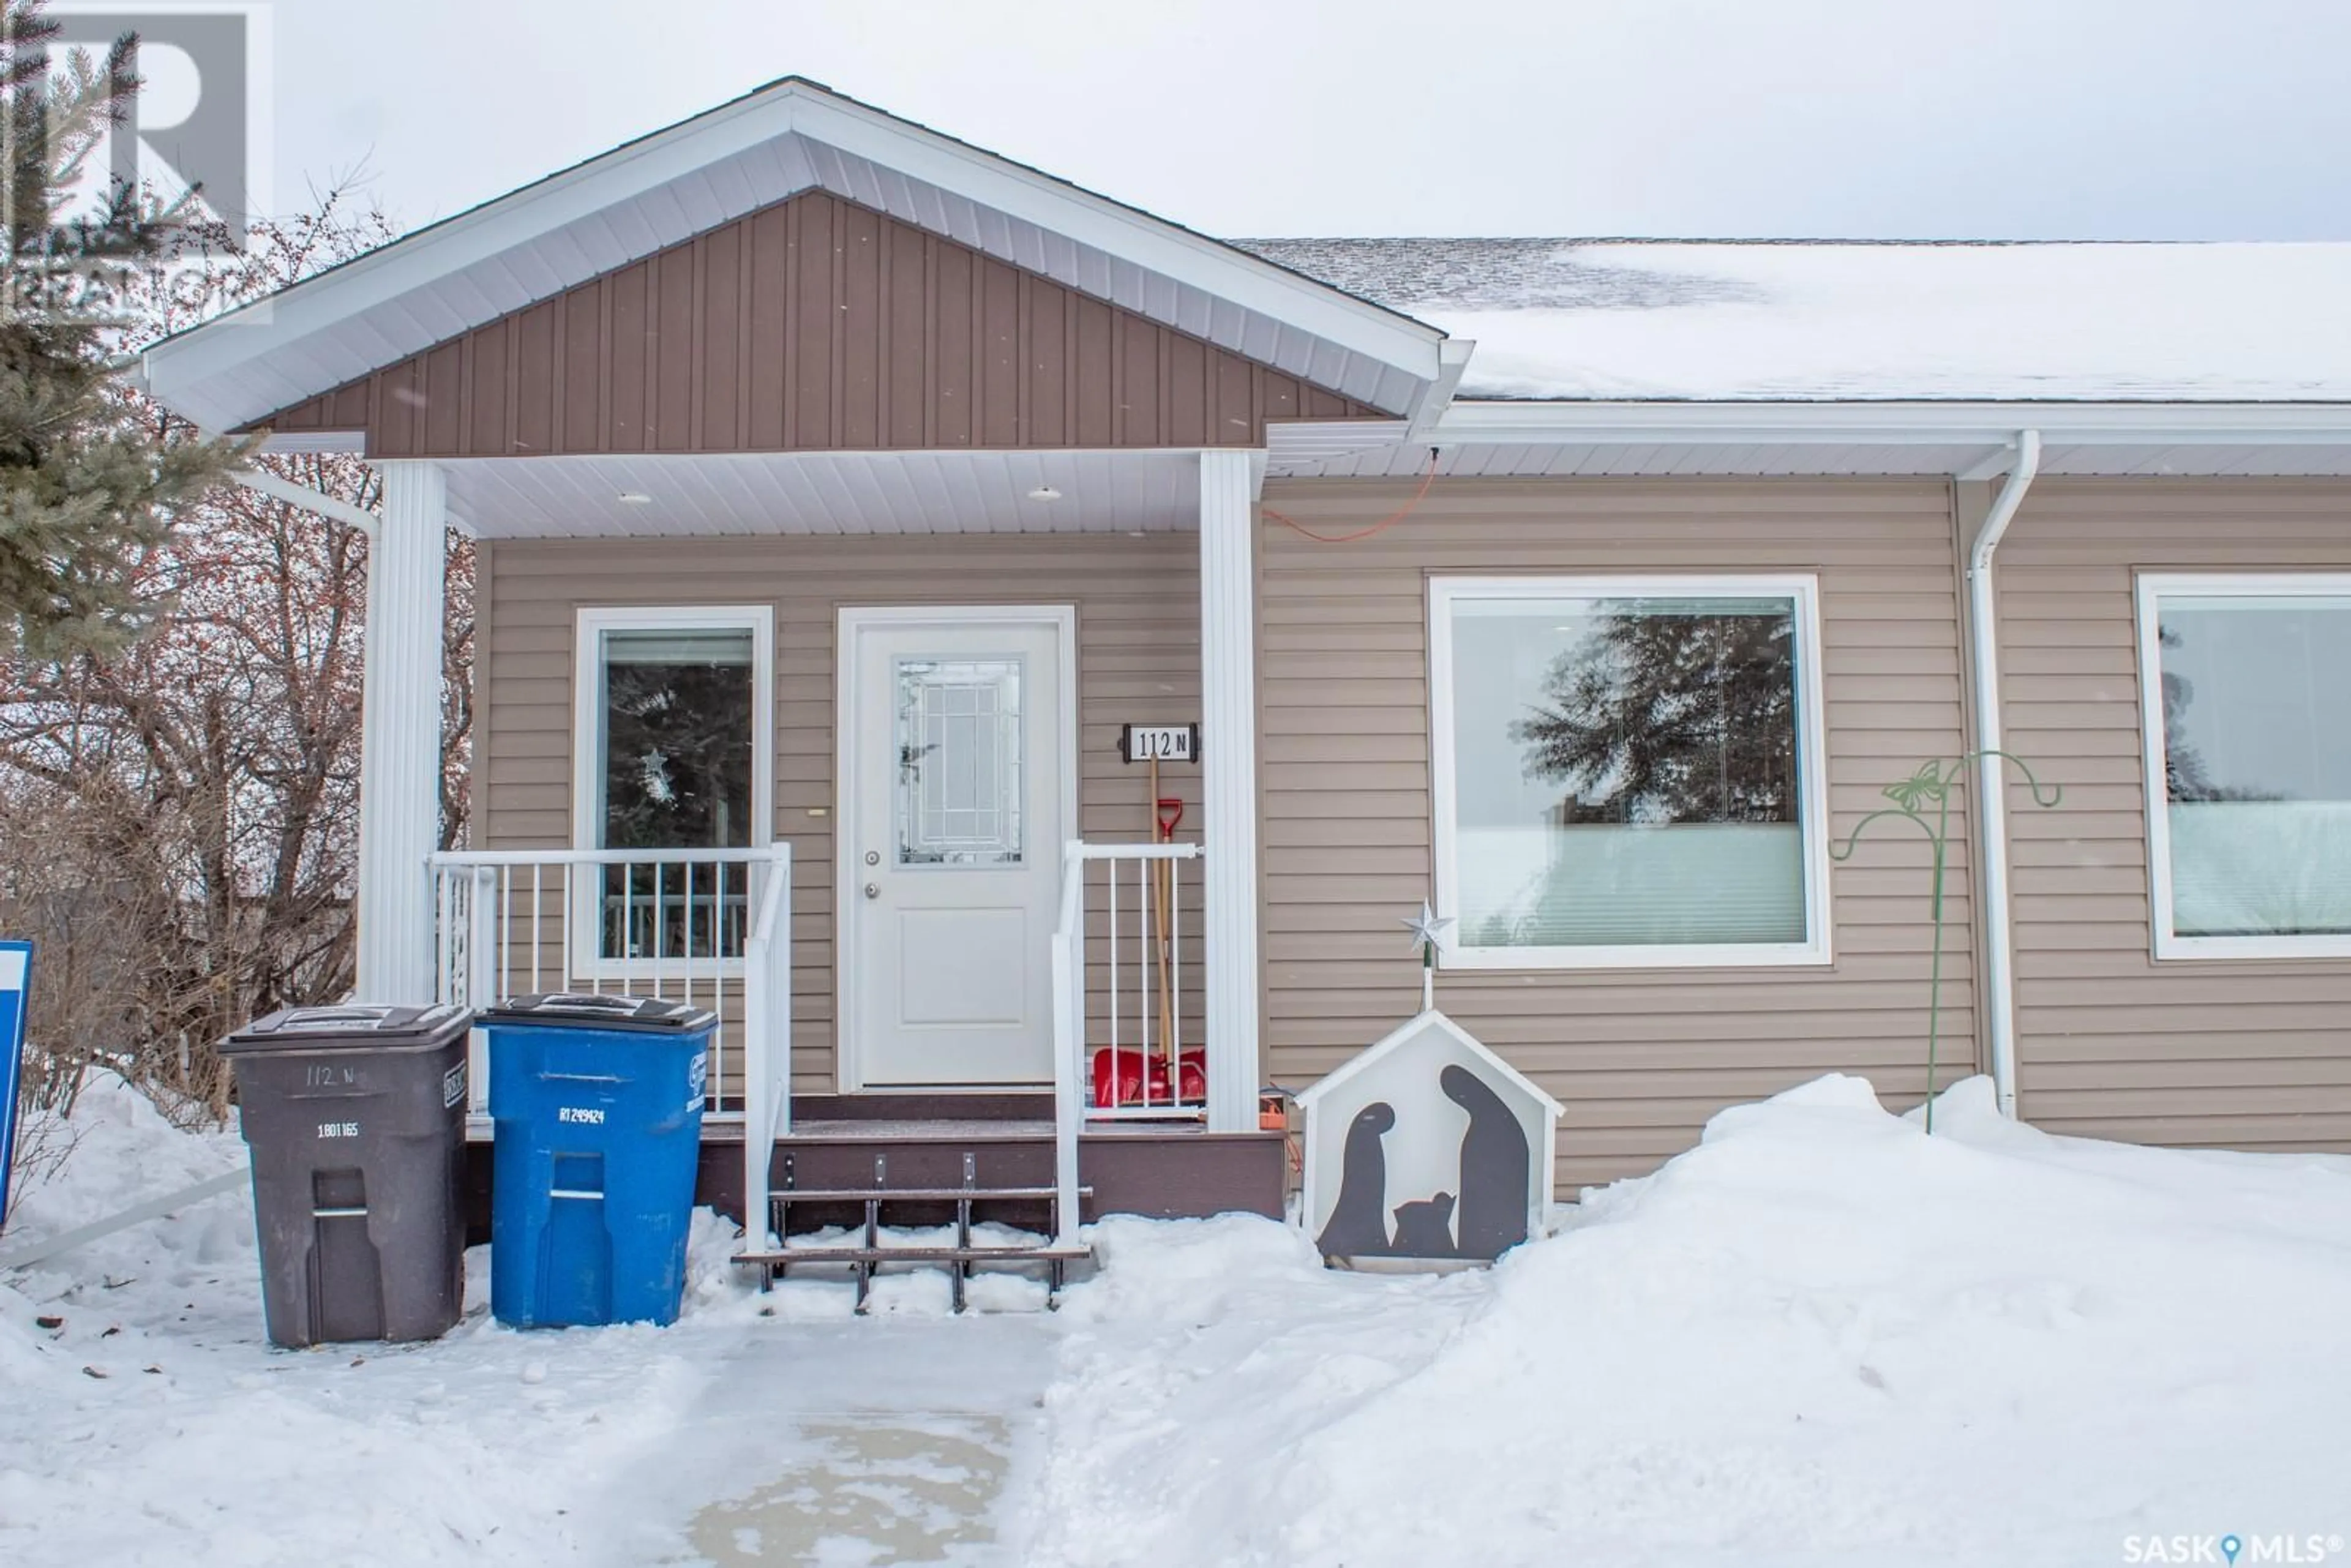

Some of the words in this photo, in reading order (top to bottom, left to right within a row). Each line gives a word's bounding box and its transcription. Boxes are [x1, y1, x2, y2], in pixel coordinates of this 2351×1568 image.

[1140, 732, 1171, 756] 112
[1176, 733, 1187, 752] N
[307, 1066, 339, 1086] 112
[343, 1067, 354, 1083] N
